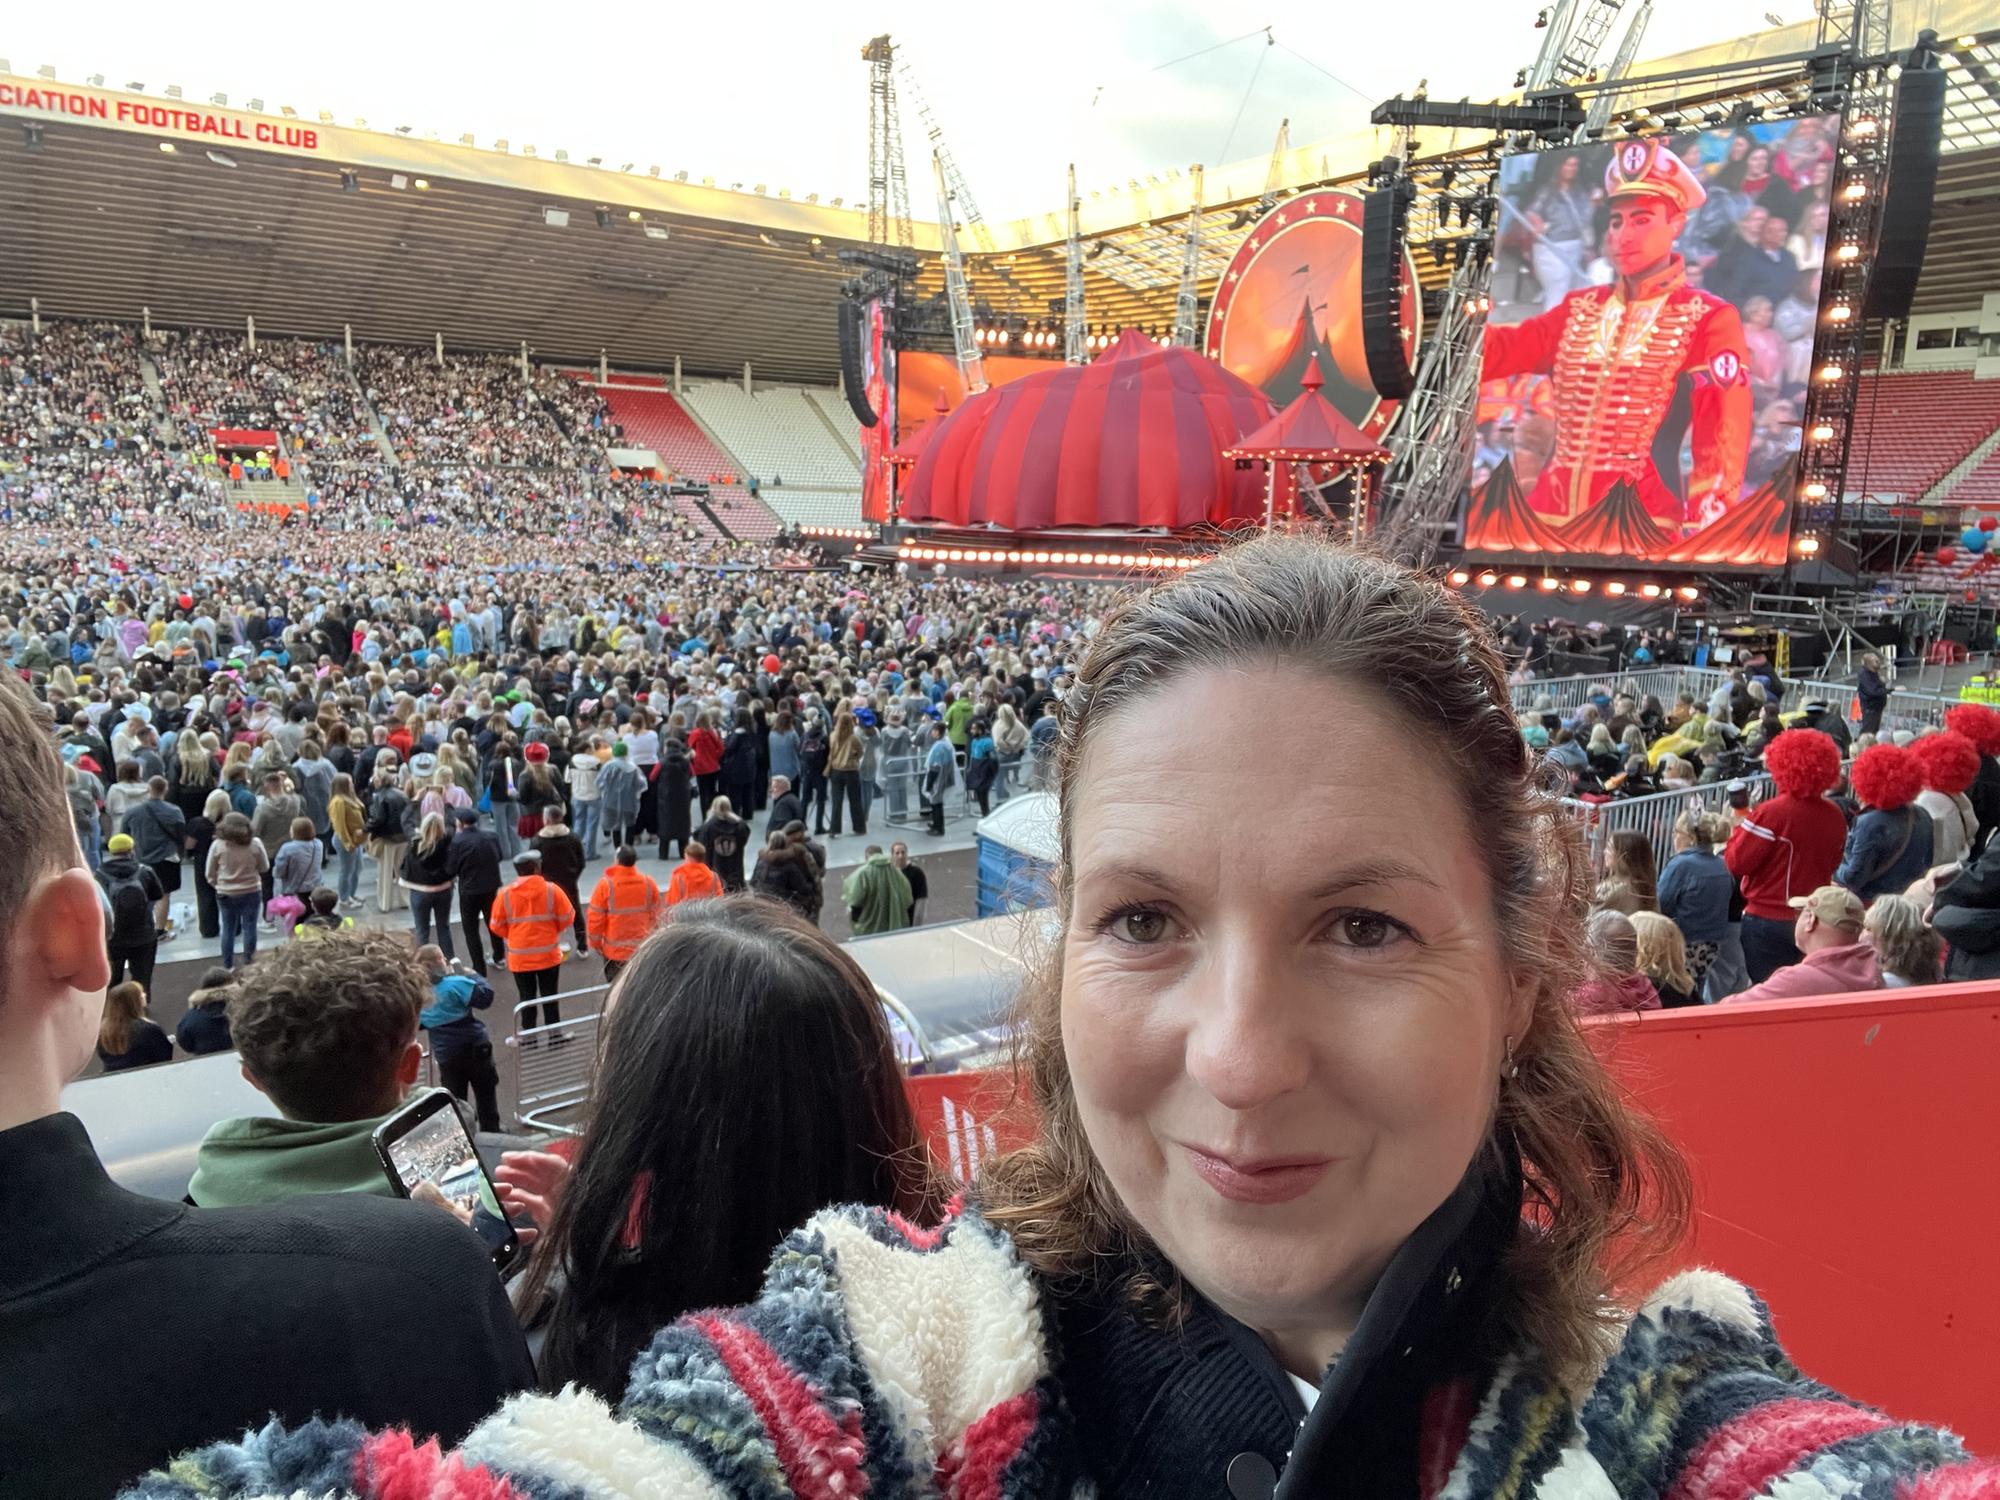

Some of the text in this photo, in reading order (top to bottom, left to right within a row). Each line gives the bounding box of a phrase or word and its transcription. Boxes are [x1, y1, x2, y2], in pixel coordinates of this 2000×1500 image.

[0, 84, 318, 149] CIATION FOOTBALL CLUB
